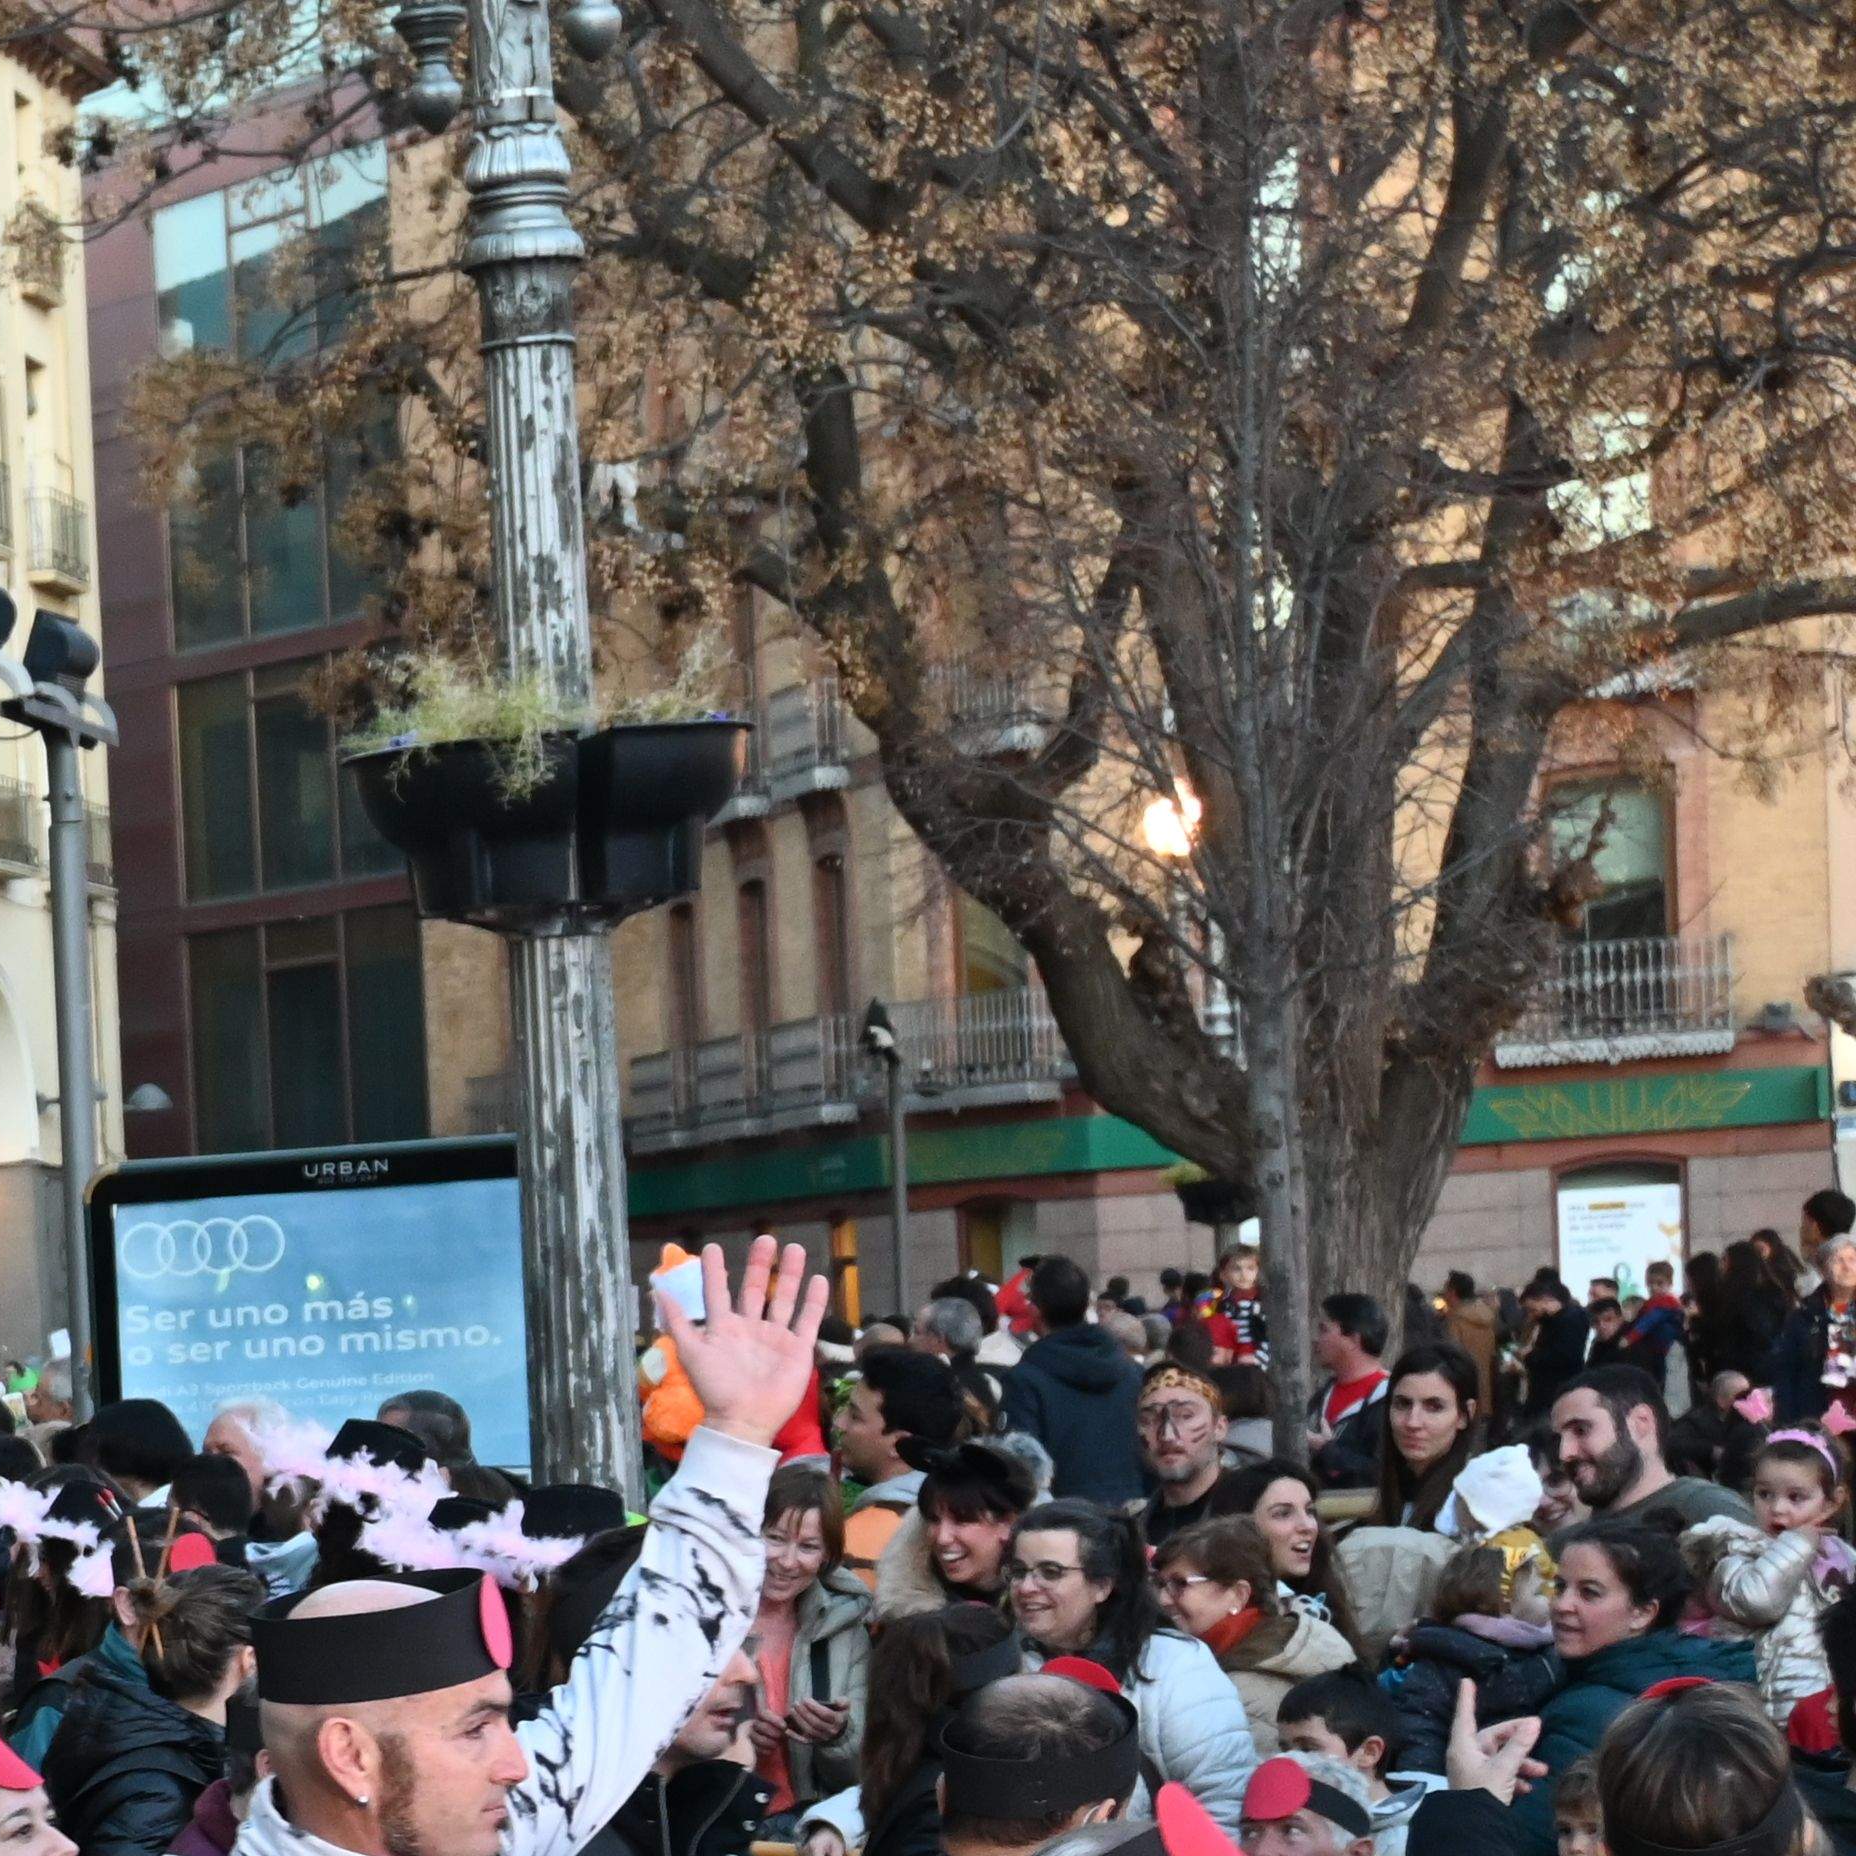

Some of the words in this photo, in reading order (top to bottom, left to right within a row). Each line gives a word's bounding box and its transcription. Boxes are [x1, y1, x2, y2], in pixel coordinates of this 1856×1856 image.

[304, 1158, 389, 1178] URBAN
[125, 1304, 195, 1333] Ser
[208, 1299, 289, 1327] uno
[303, 1291, 393, 1323] más
[127, 1344, 154, 1367] o
[168, 1338, 231, 1363] ser
[244, 1330, 326, 1358] uno
[340, 1323, 502, 1353] mismo.
[296, 1374, 368, 1390] Genuine
